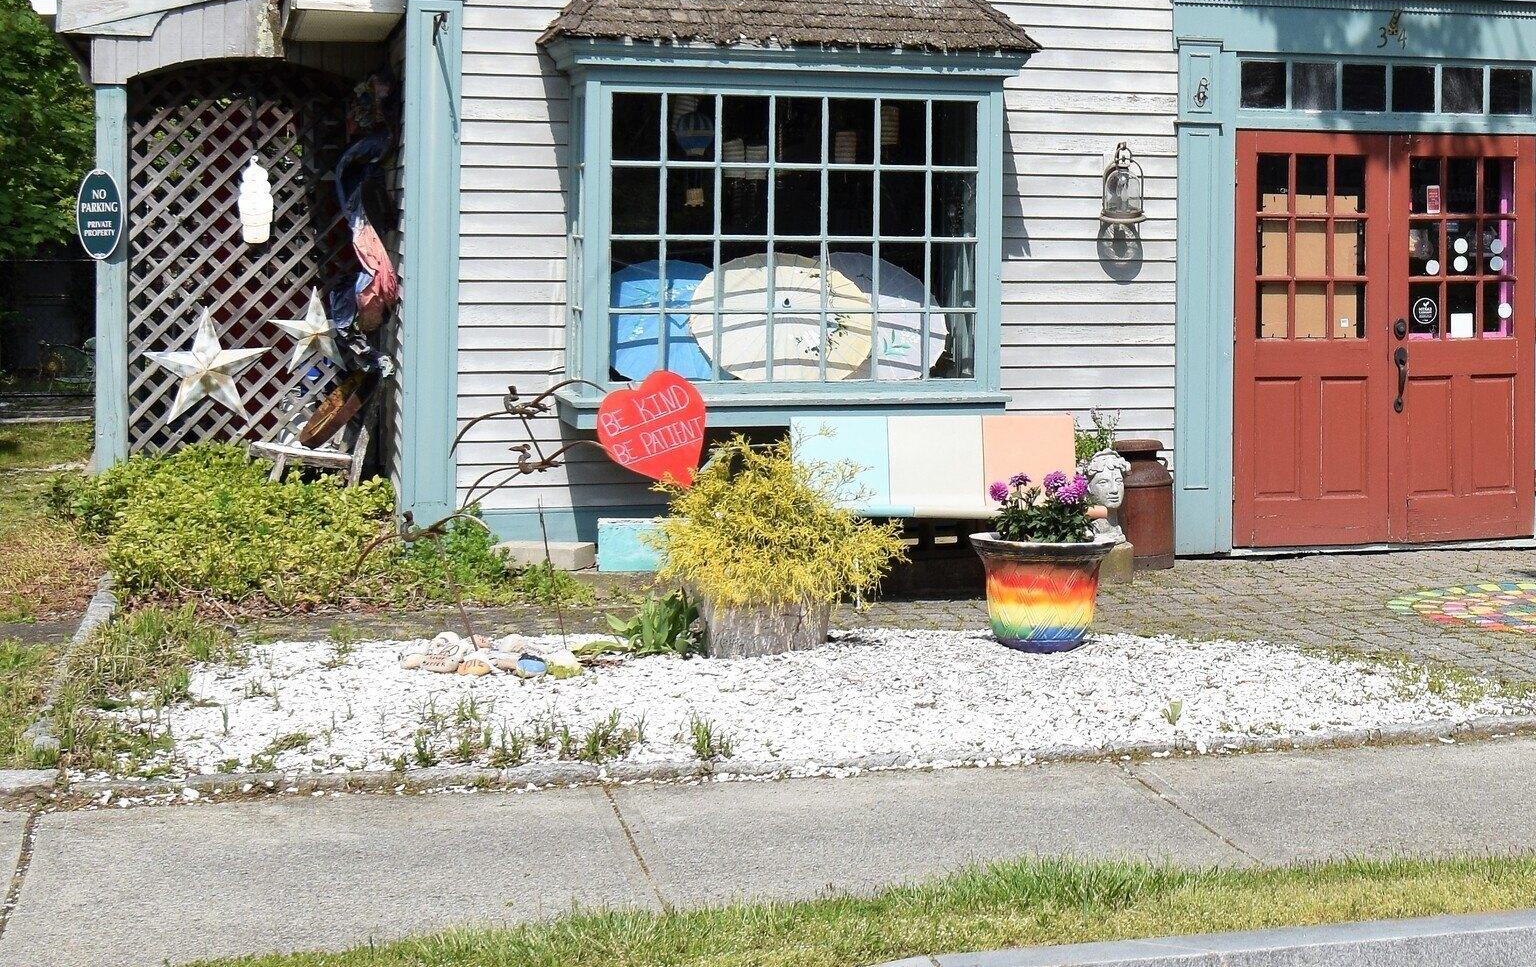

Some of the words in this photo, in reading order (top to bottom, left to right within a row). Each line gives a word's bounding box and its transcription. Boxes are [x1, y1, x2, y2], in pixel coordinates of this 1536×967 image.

[92, 189, 107, 200] NO
[81, 201, 118, 213] PARKING
[87, 220, 113, 229] PRIVATE
[84, 229, 115, 237] PROPERTY
[601, 409, 629, 436] BE
[632, 385, 690, 422] KIND
[613, 440, 638, 463] BE
[640, 416, 703, 457] PATIENT
